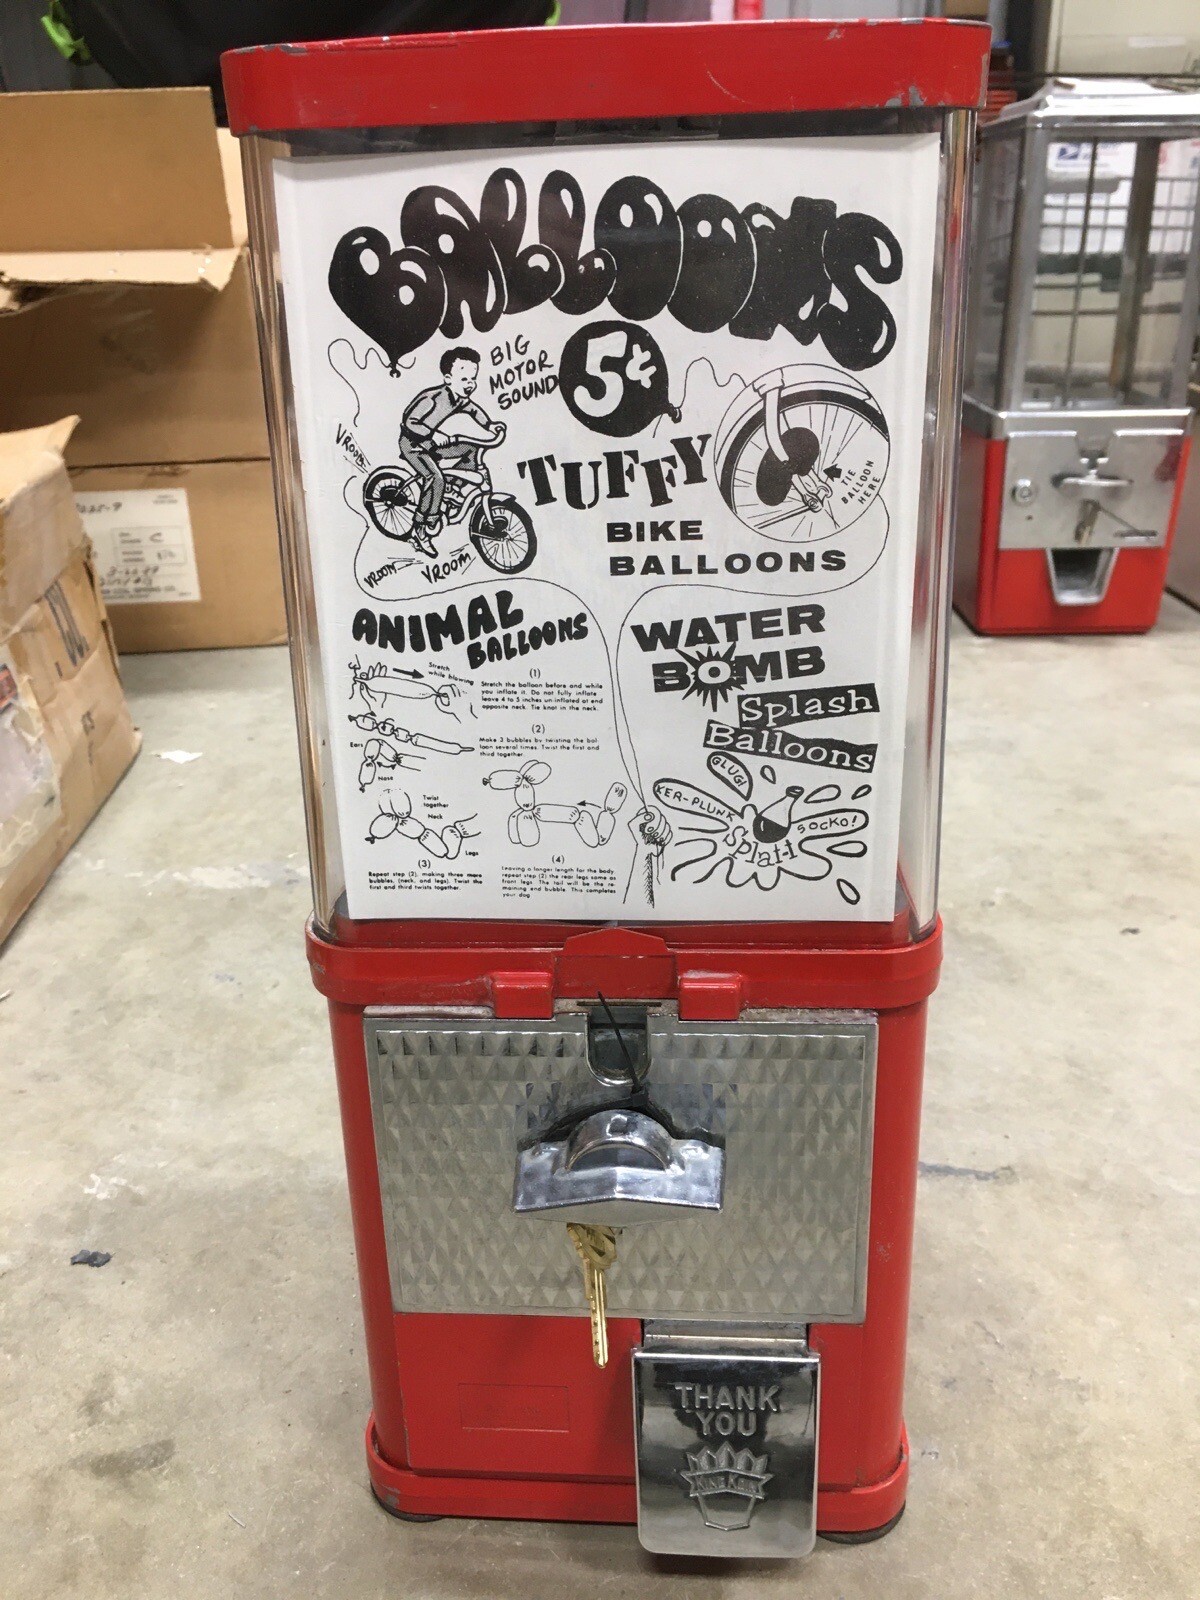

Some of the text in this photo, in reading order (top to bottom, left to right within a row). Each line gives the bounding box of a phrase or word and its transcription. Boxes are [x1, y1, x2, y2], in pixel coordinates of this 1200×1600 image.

[328, 167, 903, 371] BALLOONS
[490, 335, 530, 366] BIG
[489, 350, 554, 394] MOTOR
[573, 331, 657, 417] 5¢
[498, 375, 560, 410] SOUND
[517, 433, 711, 511] TUFFY
[841, 470, 856, 485] TIE
[841, 461, 874, 504] BALLOON
[858, 477, 880, 504] HERE
[607, 520, 703, 543] BIKE
[364, 563, 397, 588] VROOM
[421, 553, 471, 583] VROOM
[609, 549, 847, 577] BALLOONS
[352, 590, 524, 653] ANIMAL
[630, 604, 826, 652] WATER
[467, 613, 589, 669] BALLOONS
[429, 662, 450, 671] Stretch
[530, 669, 541, 678] (1)
[652, 645, 826, 693] BOMB
[741, 690, 874, 728] Splash
[531, 724, 545, 734] (2)
[707, 724, 873, 771] Balloons
[712, 756, 747, 786] GLUG!
[656, 785, 736, 822] KER-PLUNK
[797, 815, 857, 834] SOCKO!
[418, 860, 430, 869] (3)
[552, 855, 565, 864] (4)
[674, 1382, 780, 1412] THANK
[695, 1411, 757, 1436] YOU
